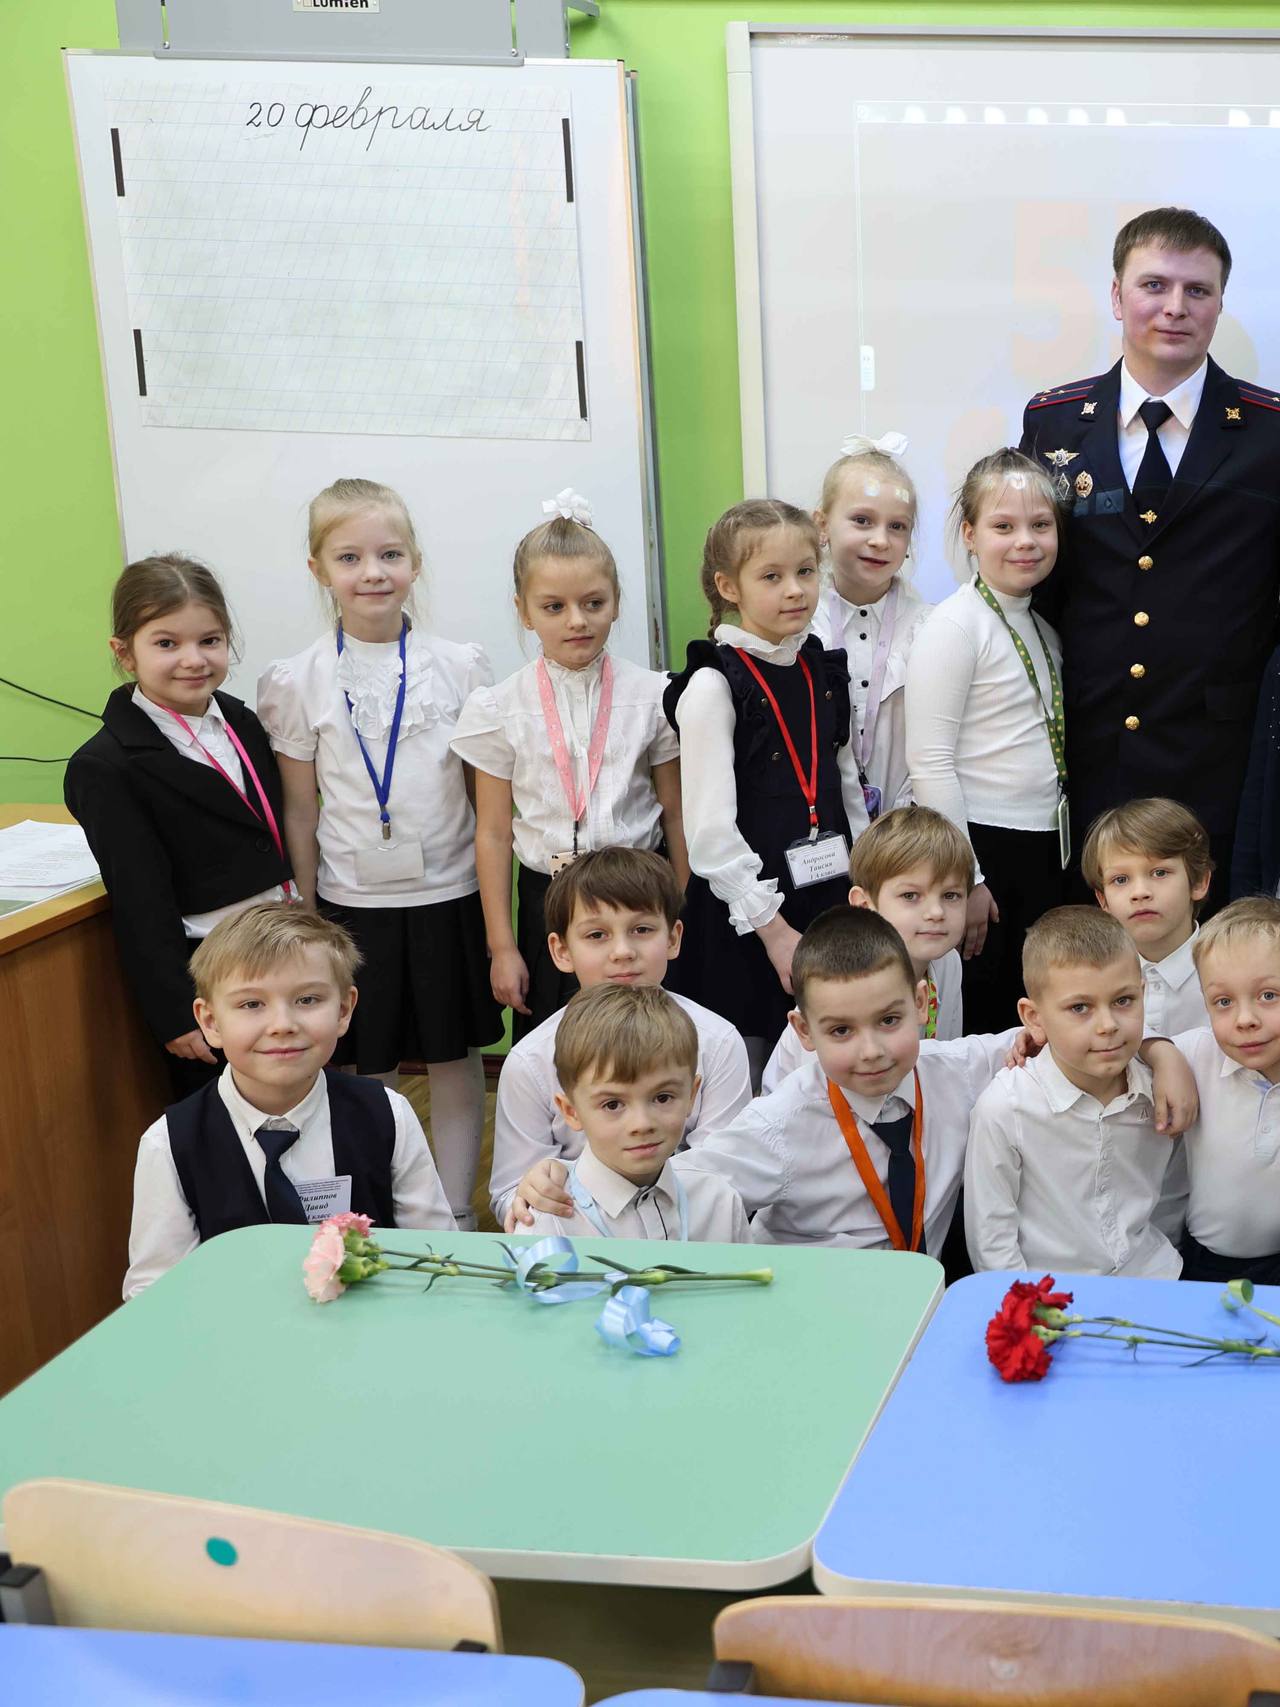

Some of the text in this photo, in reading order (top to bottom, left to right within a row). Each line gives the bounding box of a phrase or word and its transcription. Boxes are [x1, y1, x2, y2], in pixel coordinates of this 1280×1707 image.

[246, 86, 492, 151] 20 февраля
[801, 852, 836, 865] Андросова
[810, 862, 833, 872] Таисия
